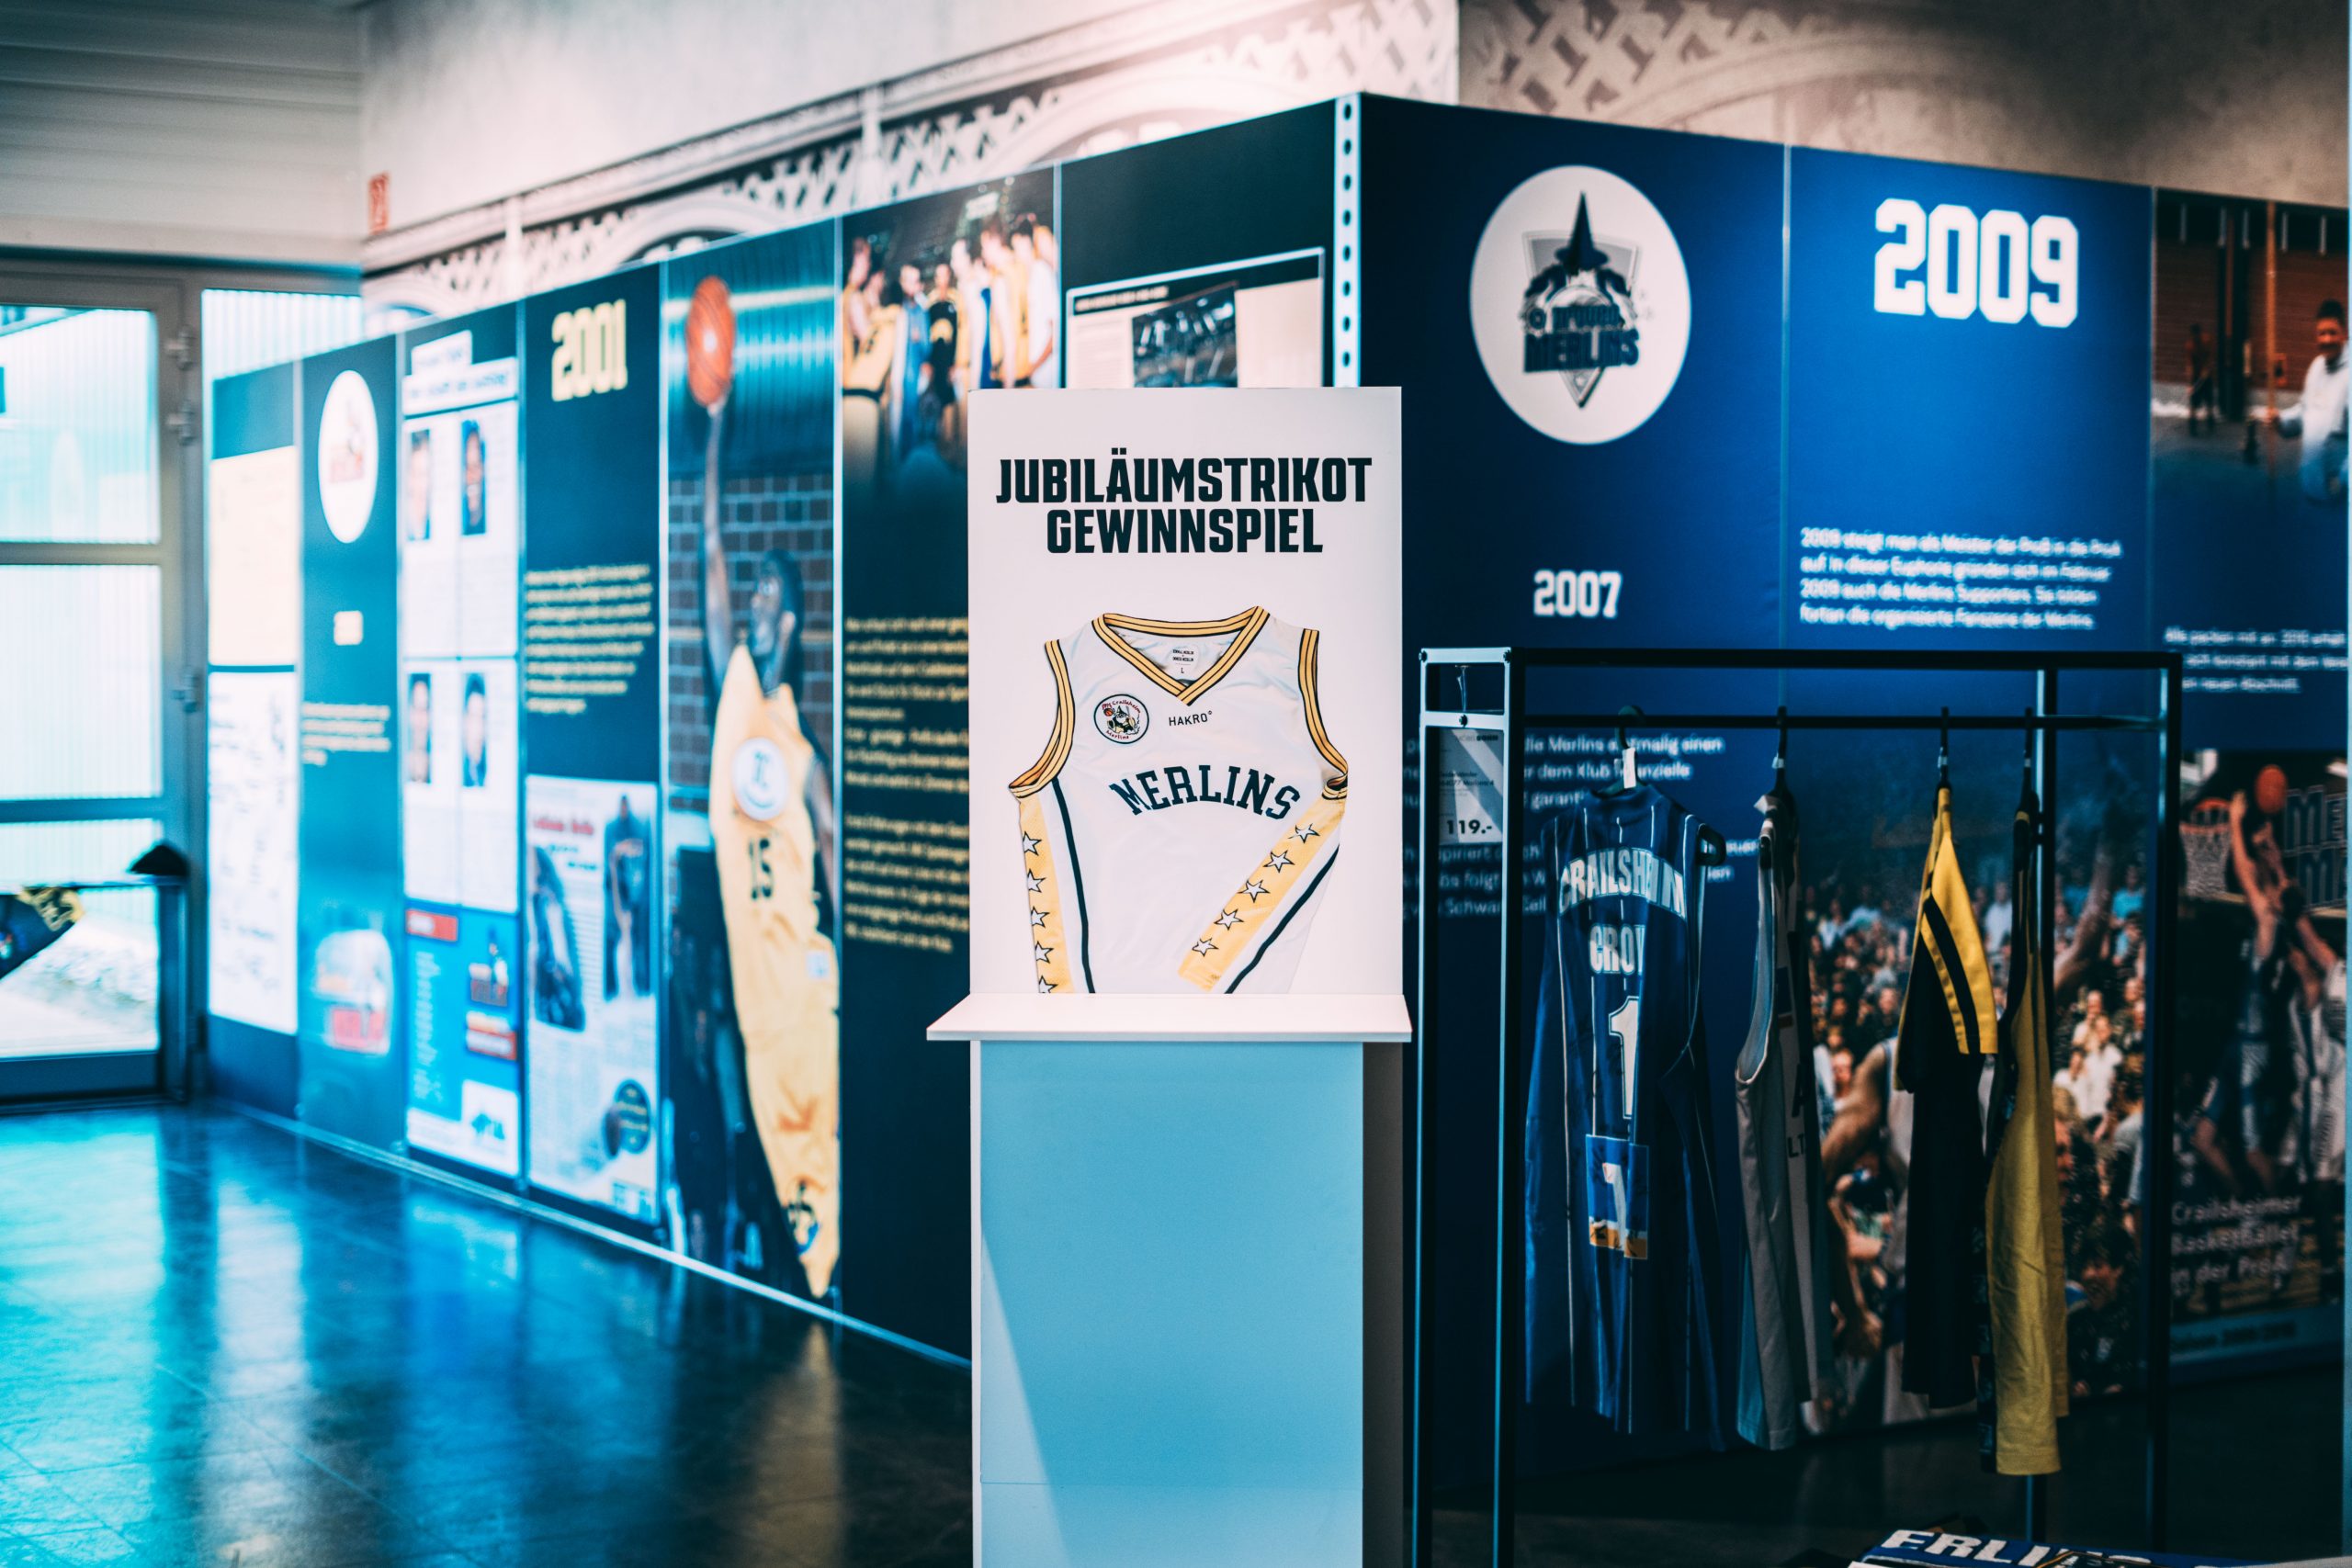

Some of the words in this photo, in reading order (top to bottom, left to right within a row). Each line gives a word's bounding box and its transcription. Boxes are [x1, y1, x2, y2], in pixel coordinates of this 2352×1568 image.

[1874, 197, 2078, 329] 2009
[552, 299, 628, 401] 2001
[996, 446, 1373, 503] JUBILÄUMSTRIKOT
[1046, 508, 1323, 553] GEWINNSPIEL
[1533, 569, 1623, 617] 2007
[1110, 764, 1301, 820] MERLINS
